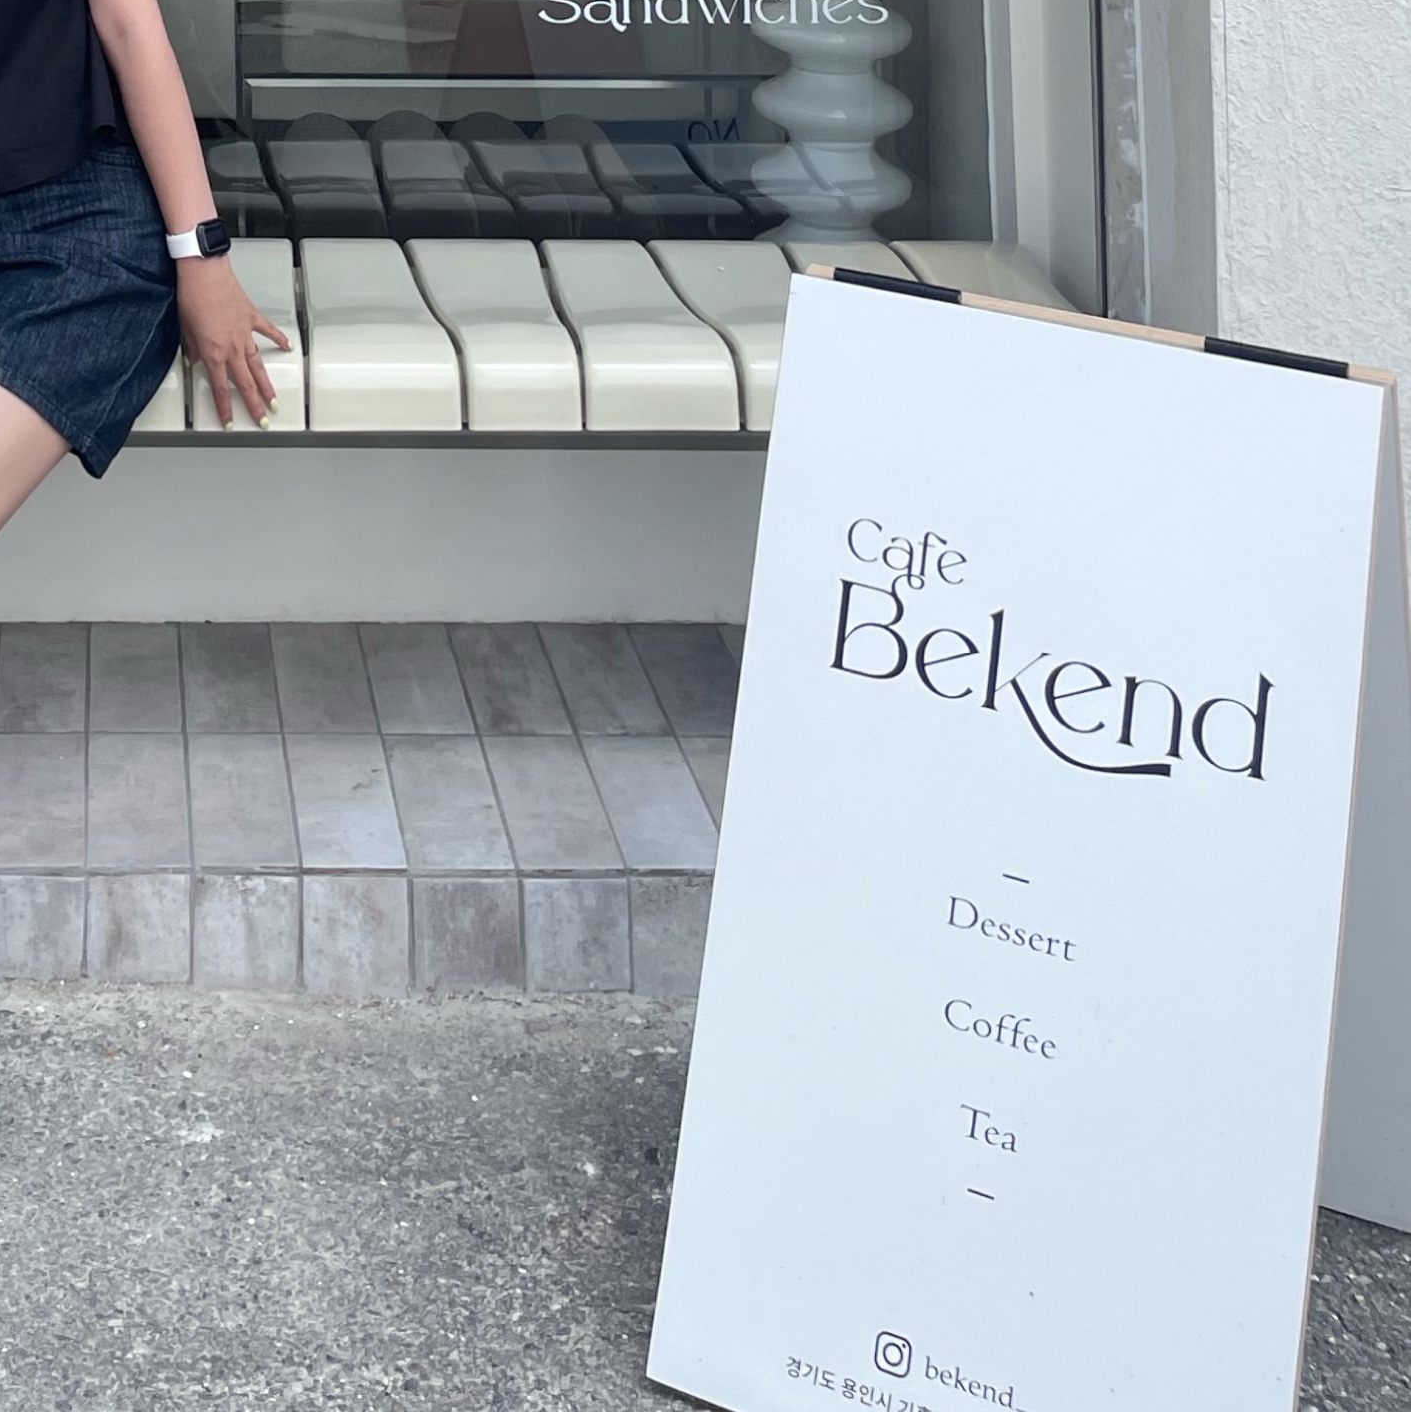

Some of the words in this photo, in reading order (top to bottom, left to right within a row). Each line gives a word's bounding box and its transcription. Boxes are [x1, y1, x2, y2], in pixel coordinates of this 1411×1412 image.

[847, 518, 968, 590] Cafe
[829, 576, 1276, 782] Bekend
[947, 895, 1078, 963] Dessert
[943, 998, 1058, 1061] Coffee
[959, 1103, 1019, 1154] Tea
[785, 1355, 836, 1391] 경기도
[841, 1377, 893, 1412] 용인시
